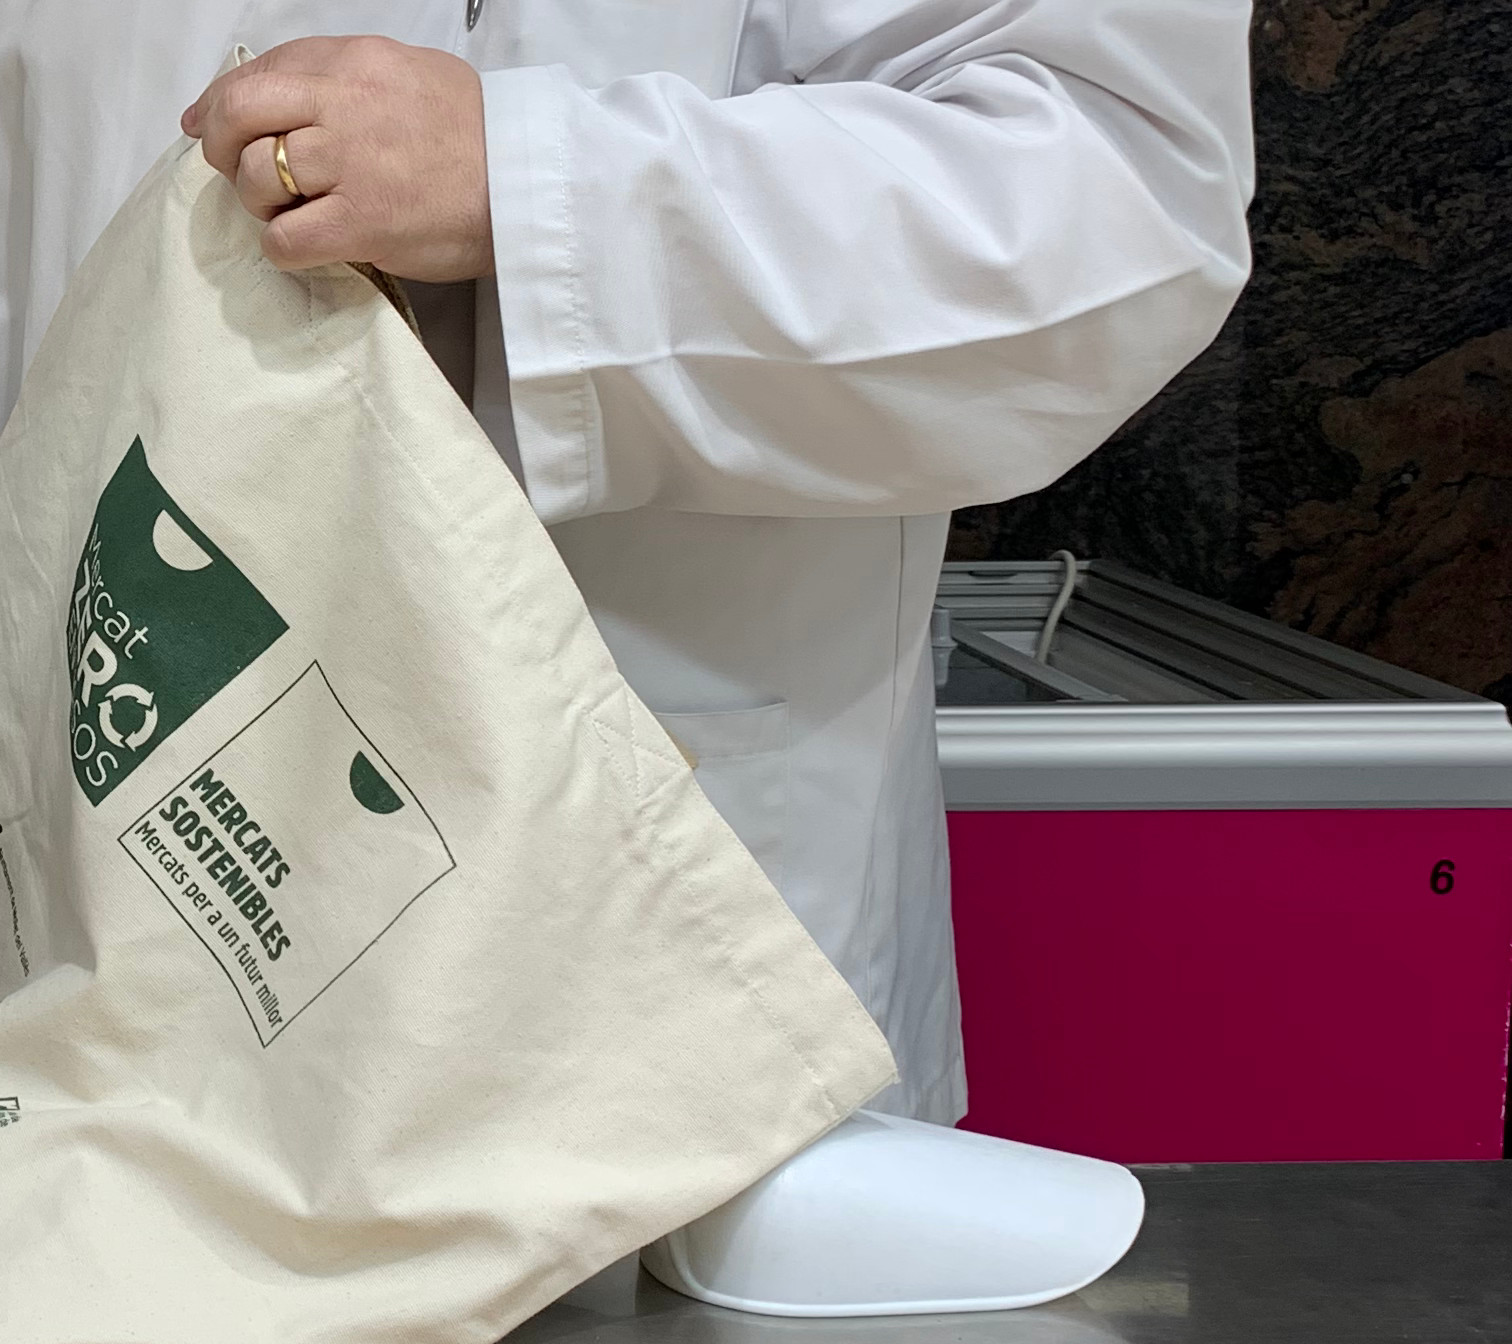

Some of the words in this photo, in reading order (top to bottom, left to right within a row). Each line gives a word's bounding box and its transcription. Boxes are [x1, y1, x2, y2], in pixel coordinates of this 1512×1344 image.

[158, 795, 291, 962] SOSTENIBLES
[188, 767, 291, 889] MERCATS
[1429, 859, 1456, 895] 6
[134, 820, 190, 886] Mercats
[181, 881, 214, 913] per
[206, 910, 223, 926] a
[217, 921, 240, 948] un
[234, 942, 265, 987] futur
[255, 983, 284, 1029] millor
